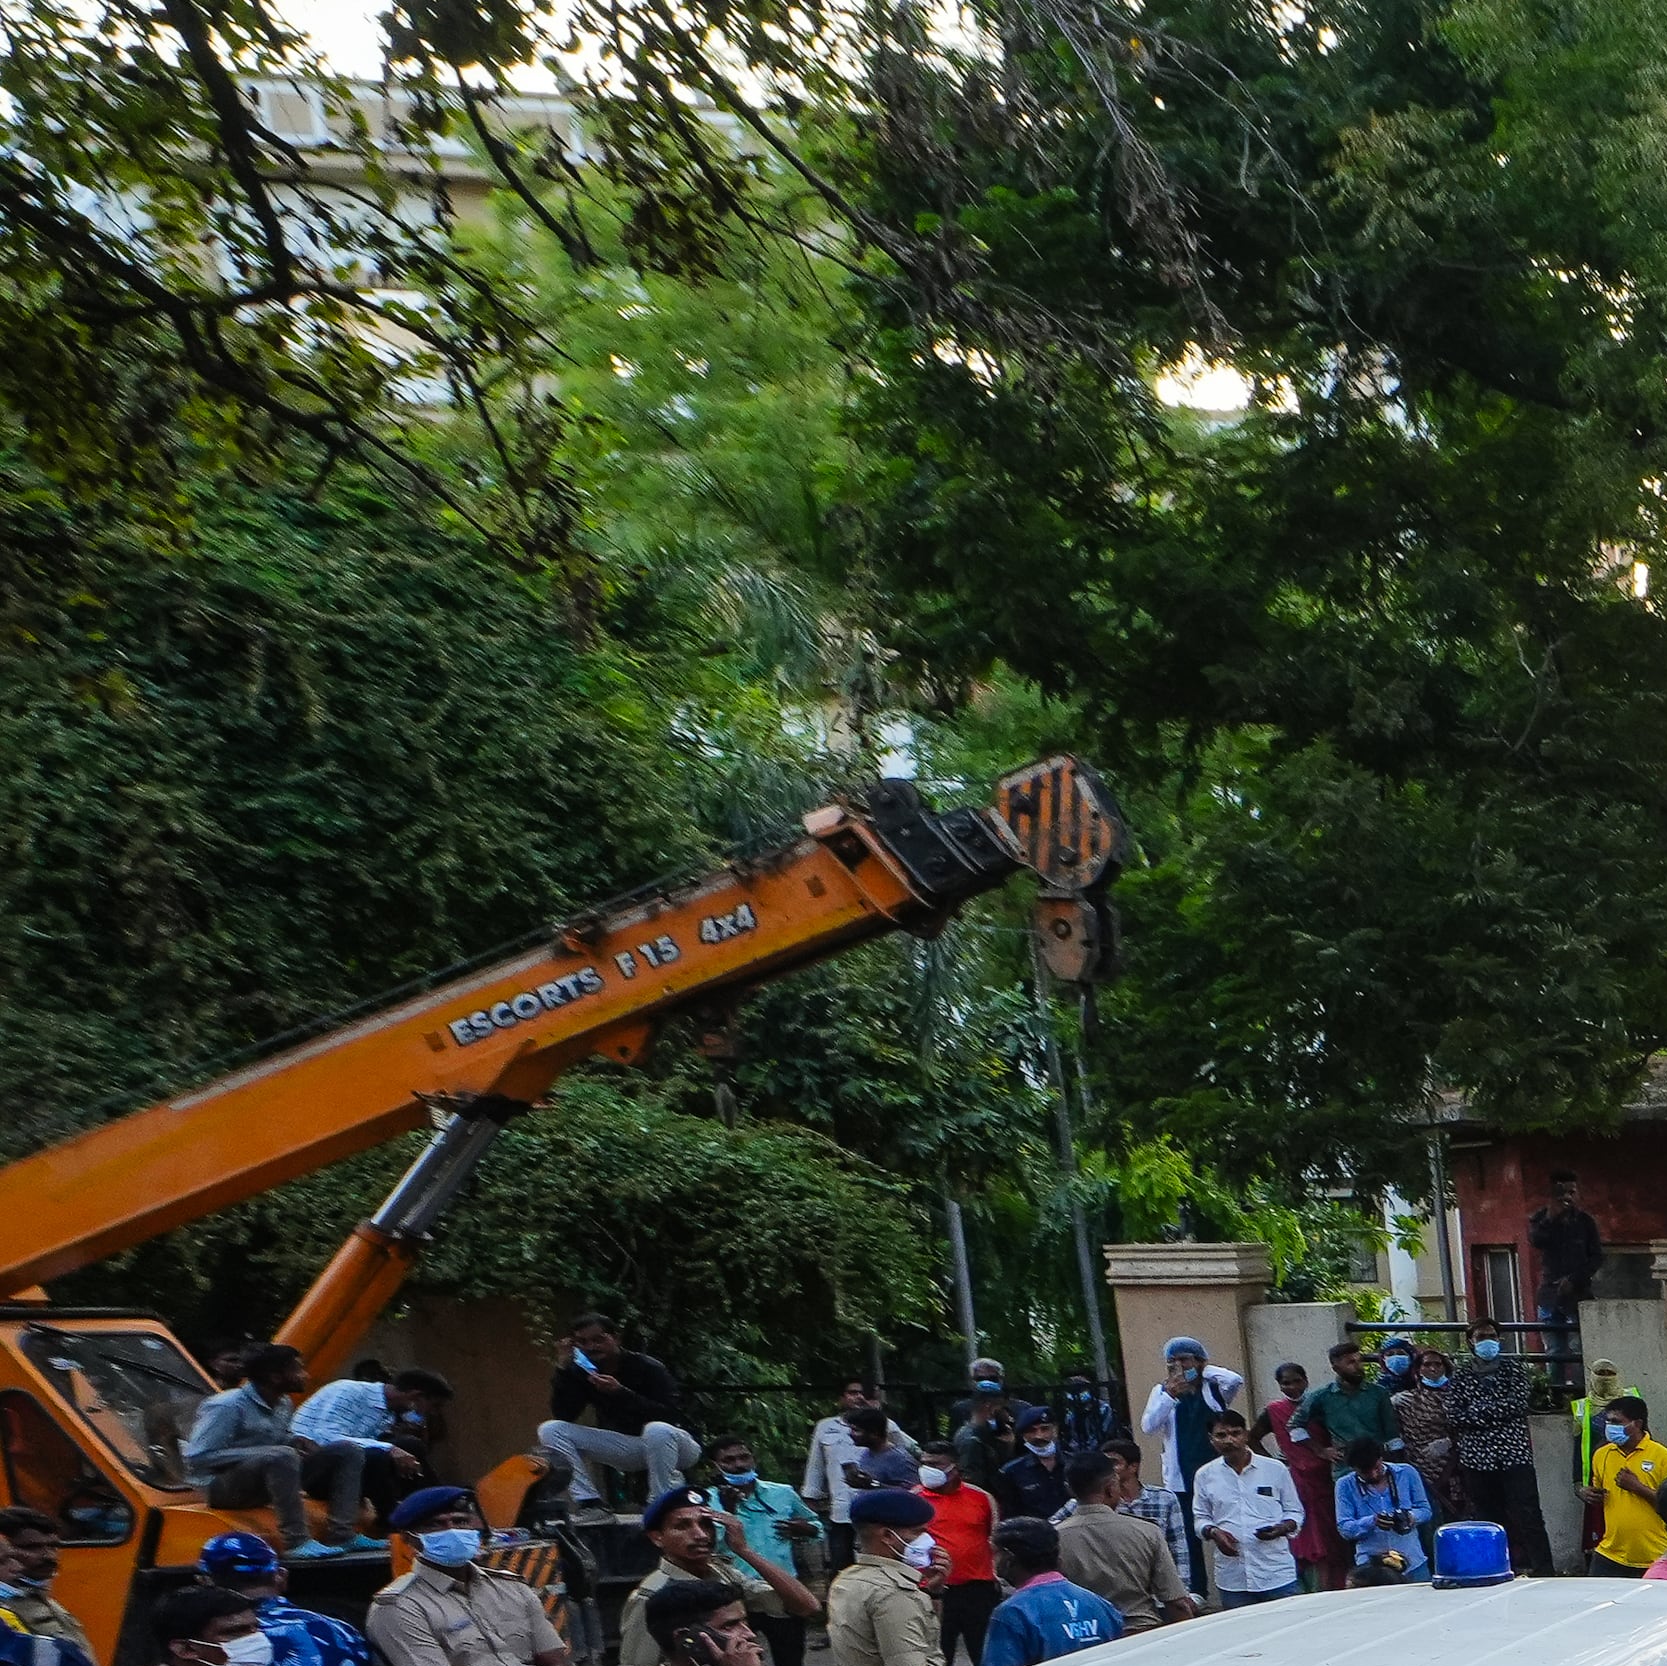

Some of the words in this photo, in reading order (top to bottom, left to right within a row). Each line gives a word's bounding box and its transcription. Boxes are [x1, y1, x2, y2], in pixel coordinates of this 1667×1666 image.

[448, 966, 605, 1047] ESCORTS
[614, 950, 637, 979] F
[636, 934, 681, 968] 15
